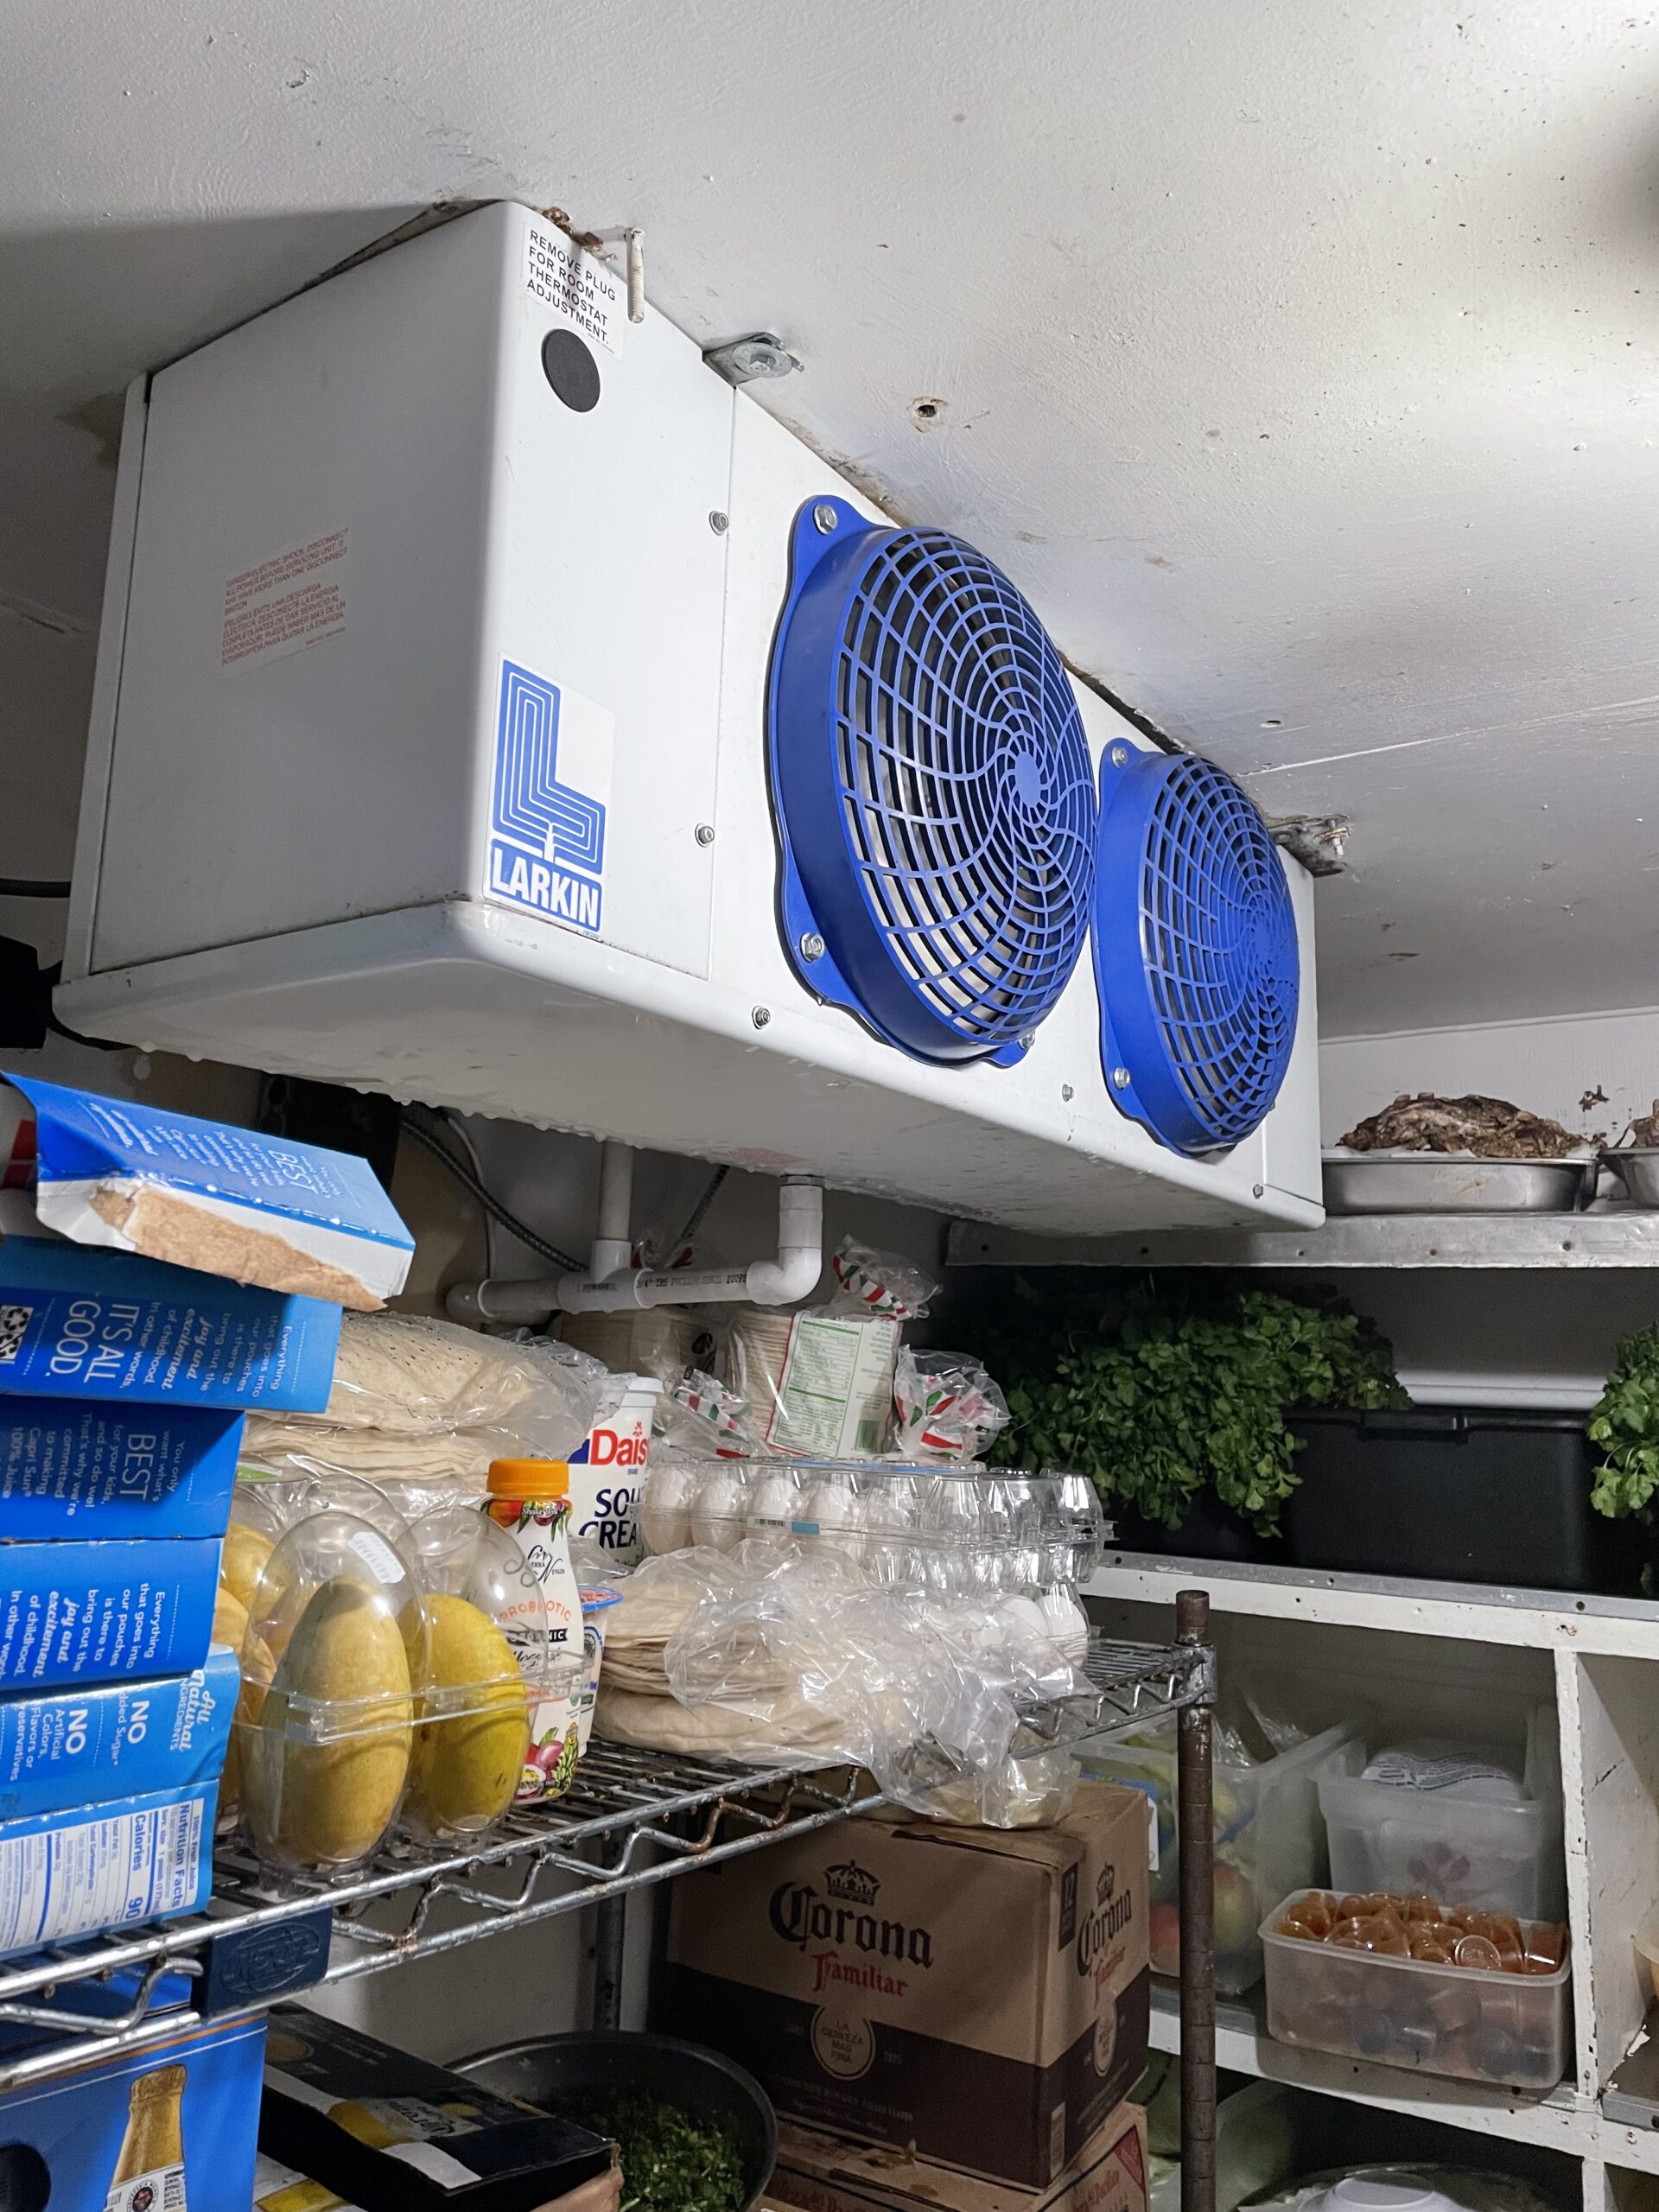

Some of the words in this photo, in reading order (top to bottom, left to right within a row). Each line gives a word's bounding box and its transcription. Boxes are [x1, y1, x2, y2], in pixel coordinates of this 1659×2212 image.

[530, 246, 554, 272] FOR
[559, 266, 594, 301] ROOM
[531, 230, 581, 275] REMOVE
[586, 270, 615, 301] PLUG
[529, 262, 607, 325] THERMOSTAT
[527, 279, 609, 344] ADJUSTMENT.
[493, 847, 599, 929] LARKIN
[266, 1149, 320, 1195] BEST
[106, 1304, 140, 1341] IT'S
[149, 1302, 162, 1313] In
[167, 1309, 177, 1322] of
[45, 1300, 101, 1376] GOOD.
[139, 1316, 157, 1348] other
[194, 1317, 213, 1346] joy
[214, 1313, 232, 1345] bring
[235, 1324, 246, 1333] is
[251, 1318, 261, 1338] our
[267, 1315, 279, 1338] that
[83, 1344, 125, 1383] ALL
[143, 1325, 175, 1384] childhood.
[161, 1308, 197, 1390] excitement
[186, 1350, 203, 1380] and
[209, 1349, 223, 1370] out
[226, 1337, 245, 1370] there
[259, 1342, 275, 1372] goes
[270, 1325, 293, 1390] Everything
[119, 1351, 143, 1389] words,
[200, 1373, 215, 1391] the
[222, 1372, 235, 1384] to
[236, 1342, 257, 1392] pouches
[251, 1376, 268, 1398] into
[10, 1427, 24, 1461] 100%
[25, 1427, 41, 1462] Capri
[46, 1431, 56, 1445] to
[79, 1412, 92, 1449] That's
[97, 1421, 106, 1444] and
[111, 1425, 124, 1441] for
[160, 1431, 171, 1459] want
[590, 1429, 649, 1466] Dais
[54, 1428, 73, 1498] committed
[73, 1452, 86, 1478] why
[94, 1448, 103, 1462] so
[107, 1446, 122, 1471] your
[119, 1433, 156, 1500] BEST
[173, 1441, 186, 1463] You
[2, 1465, 18, 1499] Juice
[35, 1448, 54, 1495] making
[91, 1465, 103, 1482] do
[152, 1463, 167, 1502] what's
[167, 1466, 179, 1492] only
[66, 1482, 81, 1516] we're
[579, 1520, 638, 1548] CREA
[10, 1590, 22, 1602] In
[29, 1595, 41, 1608] of
[61, 1598, 79, 1626] joy
[82, 1589, 99, 1623] bring
[105, 1598, 115, 1607] is
[122, 1589, 130, 1610] our
[138, 1583, 149, 1607] that
[499, 1600, 571, 1621] PROBOTIC
[5, 1605, 20, 1639] other
[32, 1591, 60, 1678] excitement
[79, 1627, 92, 1649] out
[99, 1611, 113, 1644] there
[134, 1611, 145, 1642] goes
[144, 1592, 165, 1658] Everything
[13, 1611, 39, 1676] childhood.
[57, 1631, 72, 1663] and
[94, 1648, 105, 1661] to
[110, 1614, 129, 1666] pouches
[73, 1651, 86, 1672] the
[126, 1646, 140, 1669] into
[117, 1694, 128, 1725] dded
[127, 1700, 149, 1745] NO
[170, 1678, 188, 1751] NGREDIENTS
[197, 1690, 216, 1725] All
[10, 1703, 28, 1781] reservatives
[27, 1707, 40, 1752] Flavors
[38, 1714, 53, 1758] Colors,
[50, 1709, 65, 1760] Artificial
[65, 1709, 88, 1754] NO
[25, 1756, 35, 1768] or
[132, 1815, 146, 1872] Calories
[176, 1805, 189, 1866] Nutrition
[172, 1870, 185, 1908] Facts
[126, 1897, 143, 1919] 90
[770, 1881, 933, 1968] Corona
[1077, 1889, 1131, 1978] Corona
[811, 1949, 909, 1997] Familiar
